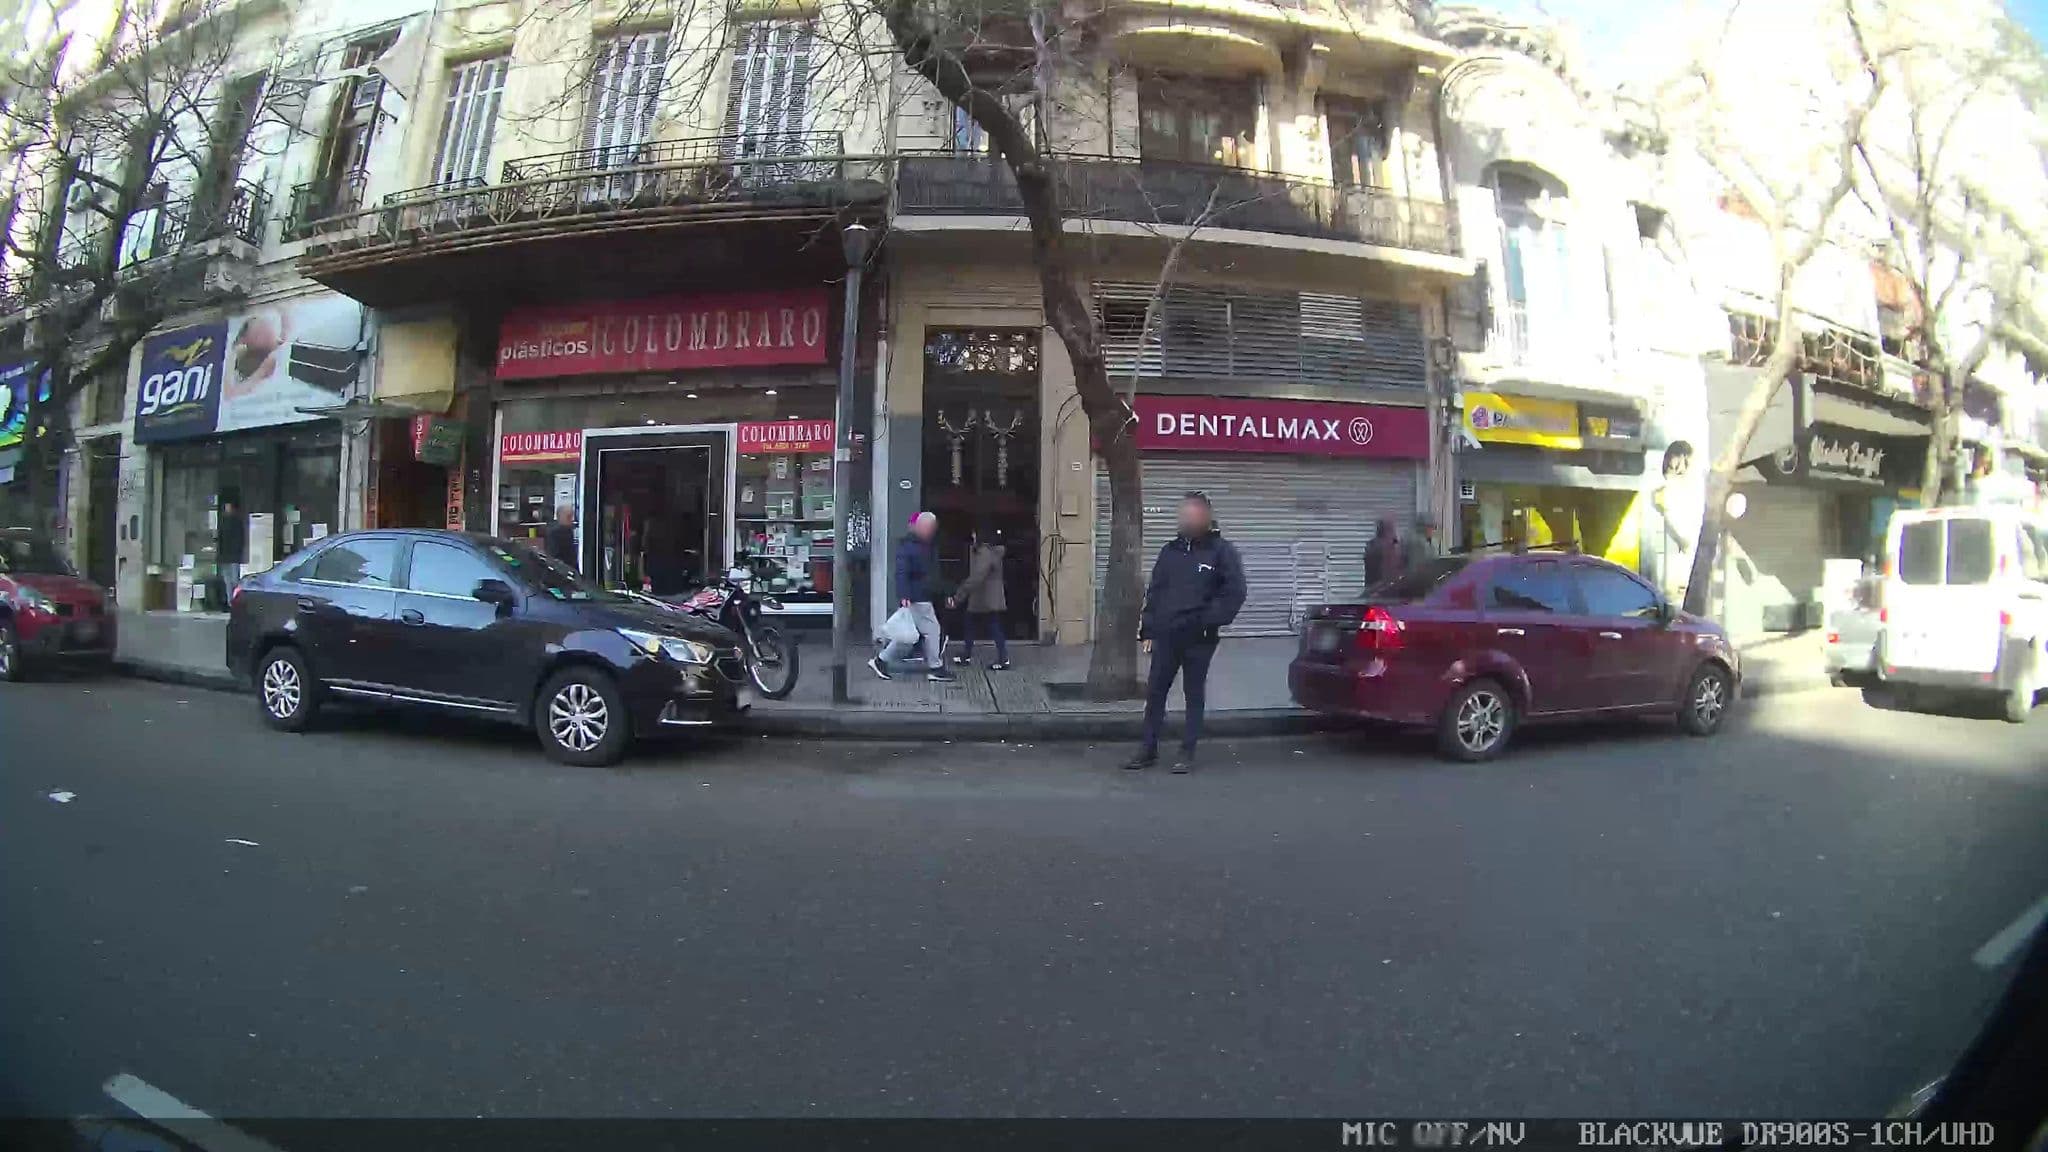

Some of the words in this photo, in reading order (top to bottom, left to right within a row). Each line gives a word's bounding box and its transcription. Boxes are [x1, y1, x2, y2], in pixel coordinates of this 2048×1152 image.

[499, 339, 588, 368] plásticos
[602, 308, 818, 354] COLOMBRARO
[141, 362, 214, 415] gani
[741, 424, 831, 442] COLOMBRARO
[1157, 413, 1341, 440] DENTALMAX
[503, 432, 580, 451] COLOMBRARO
